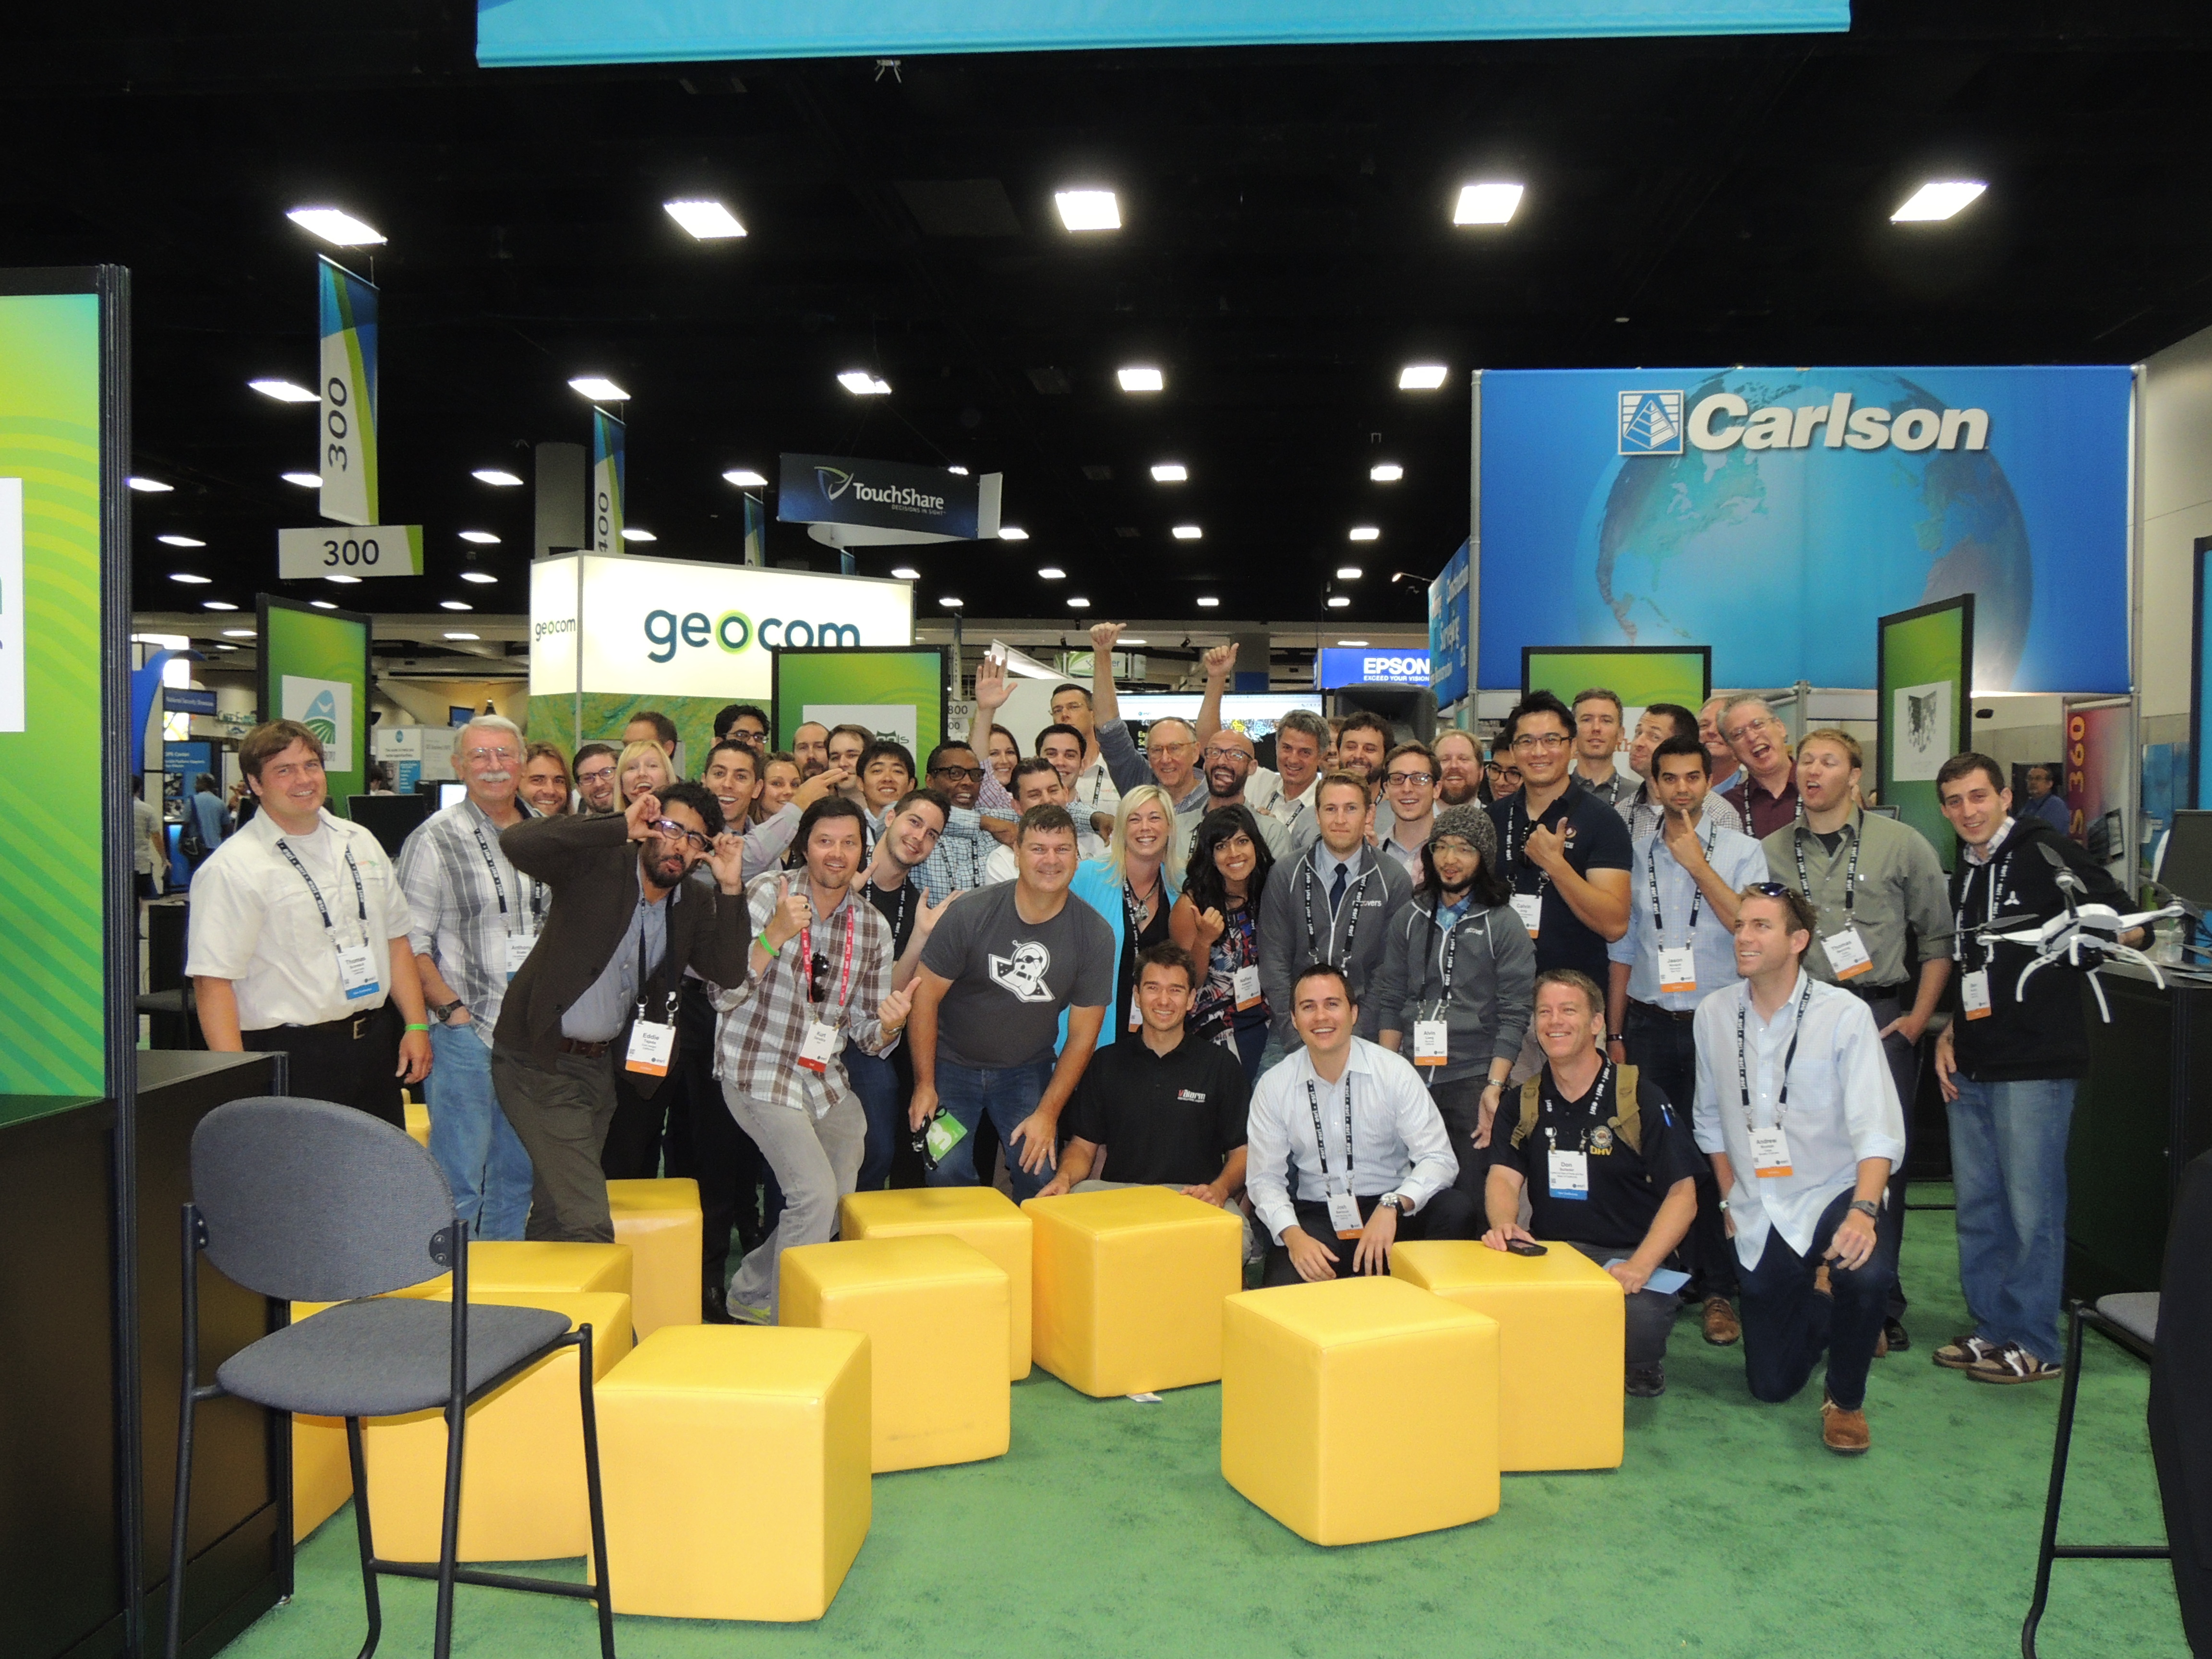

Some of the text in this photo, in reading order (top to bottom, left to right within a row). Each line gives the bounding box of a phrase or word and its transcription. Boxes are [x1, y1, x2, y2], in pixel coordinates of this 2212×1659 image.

[328, 377, 348, 472] 300
[1687, 392, 1988, 451] Carlson
[853, 482, 944, 509] TouchShare
[891, 505, 920, 513] DECISIONS
[598, 491, 609, 553] 400
[323, 539, 379, 567] 300
[535, 618, 576, 642] geocom
[644, 609, 860, 663] geocom
[1363, 658, 1430, 675] EPSON
[948, 706, 968, 714] 800
[283, 849, 327, 913] esri esri esri esri
[1589, 1068, 1610, 1115] esri esri esri
